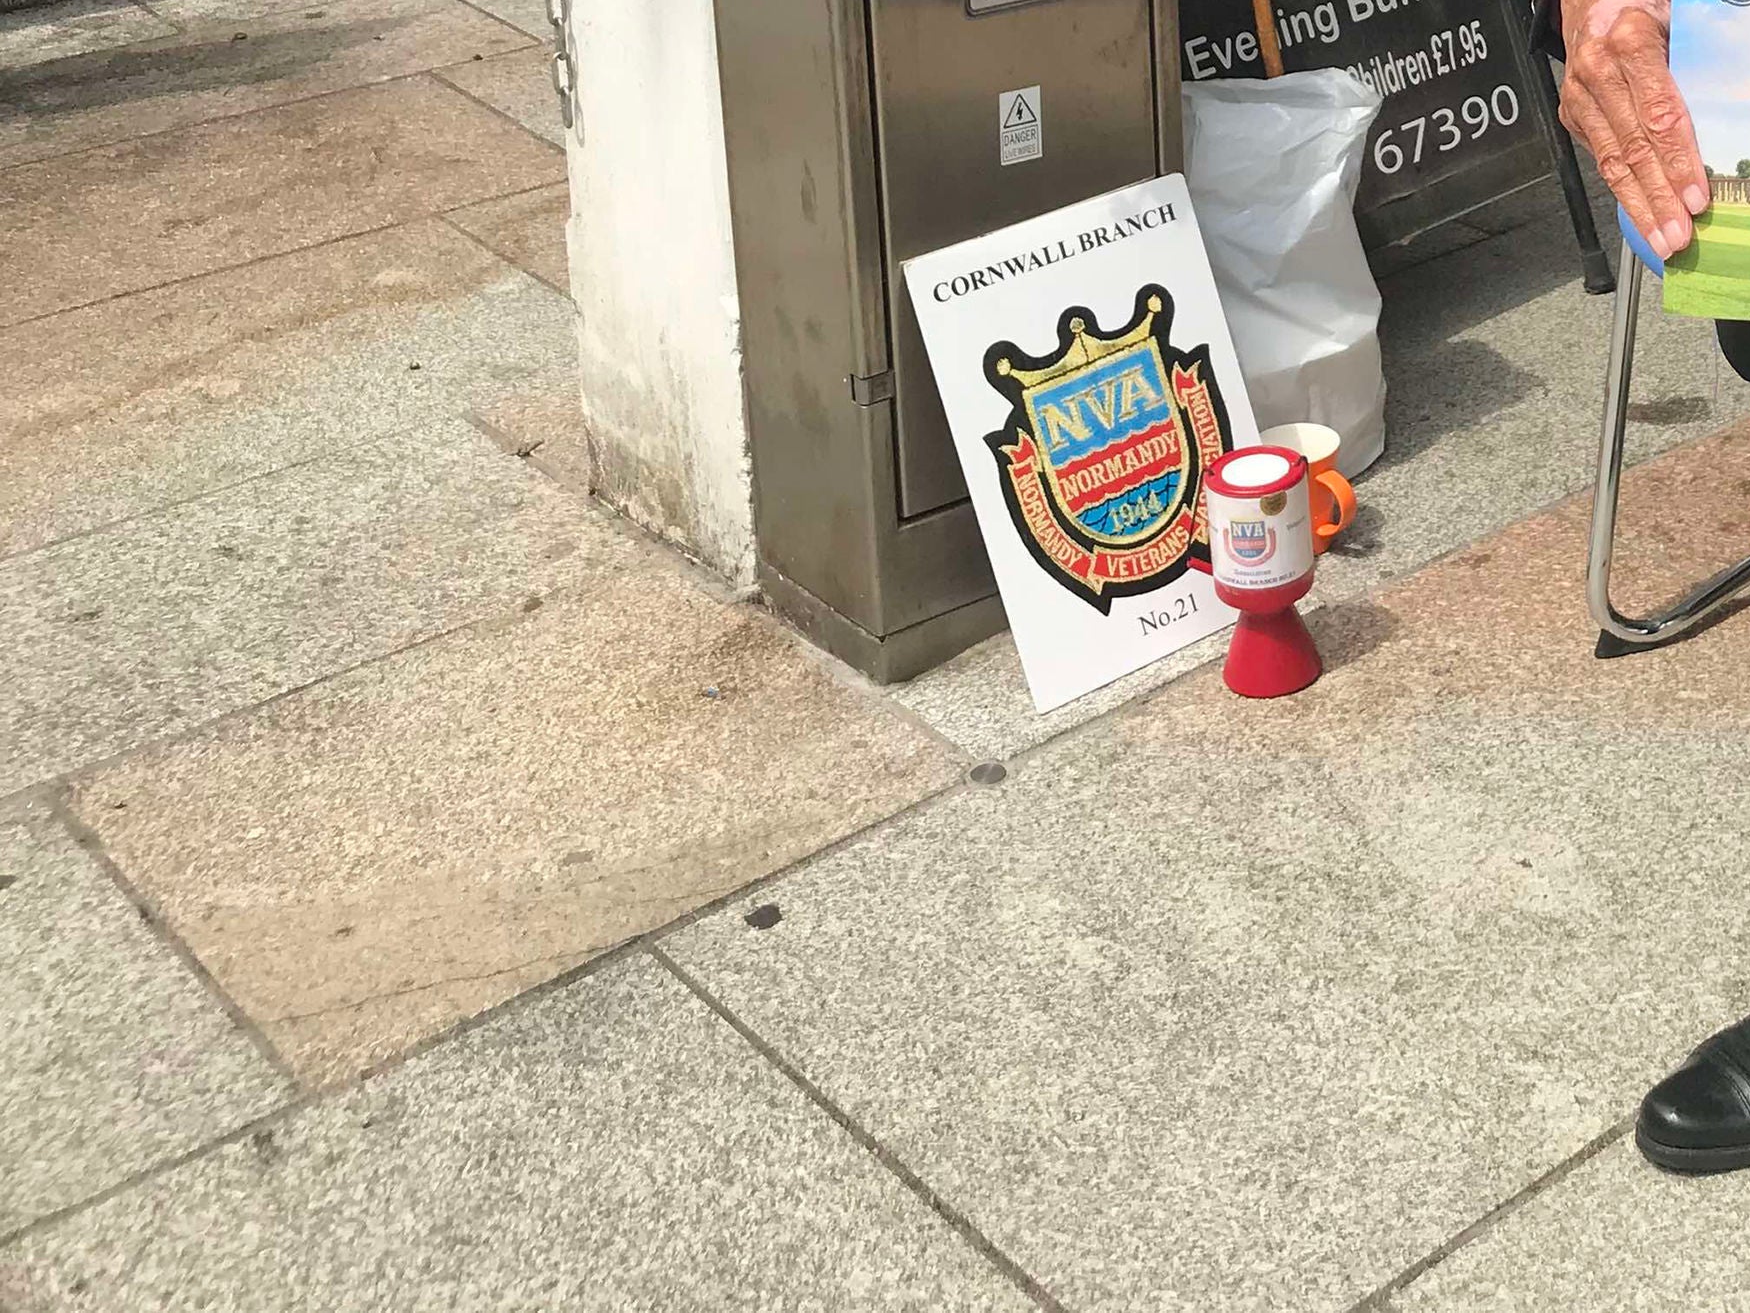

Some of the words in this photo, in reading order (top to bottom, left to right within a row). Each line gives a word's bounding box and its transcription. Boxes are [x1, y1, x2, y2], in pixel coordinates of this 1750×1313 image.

[1430, 20, 1487, 76] £7.95
[1004, 128, 1037, 147] DANGER
[1374, 84, 1519, 174] 67390
[933, 240, 1076, 303] CORNWALL
[1077, 202, 1177, 254] BRANCH
[1040, 364, 1164, 453] NVA
[1059, 429, 1180, 502] NORMANDY
[1016, 471, 1083, 569] NORMANDY
[1105, 526, 1190, 576] VETERANS
[1108, 489, 1164, 534] 1944
[1232, 521, 1264, 537] NVA
[1138, 593, 1199, 636] No.21
